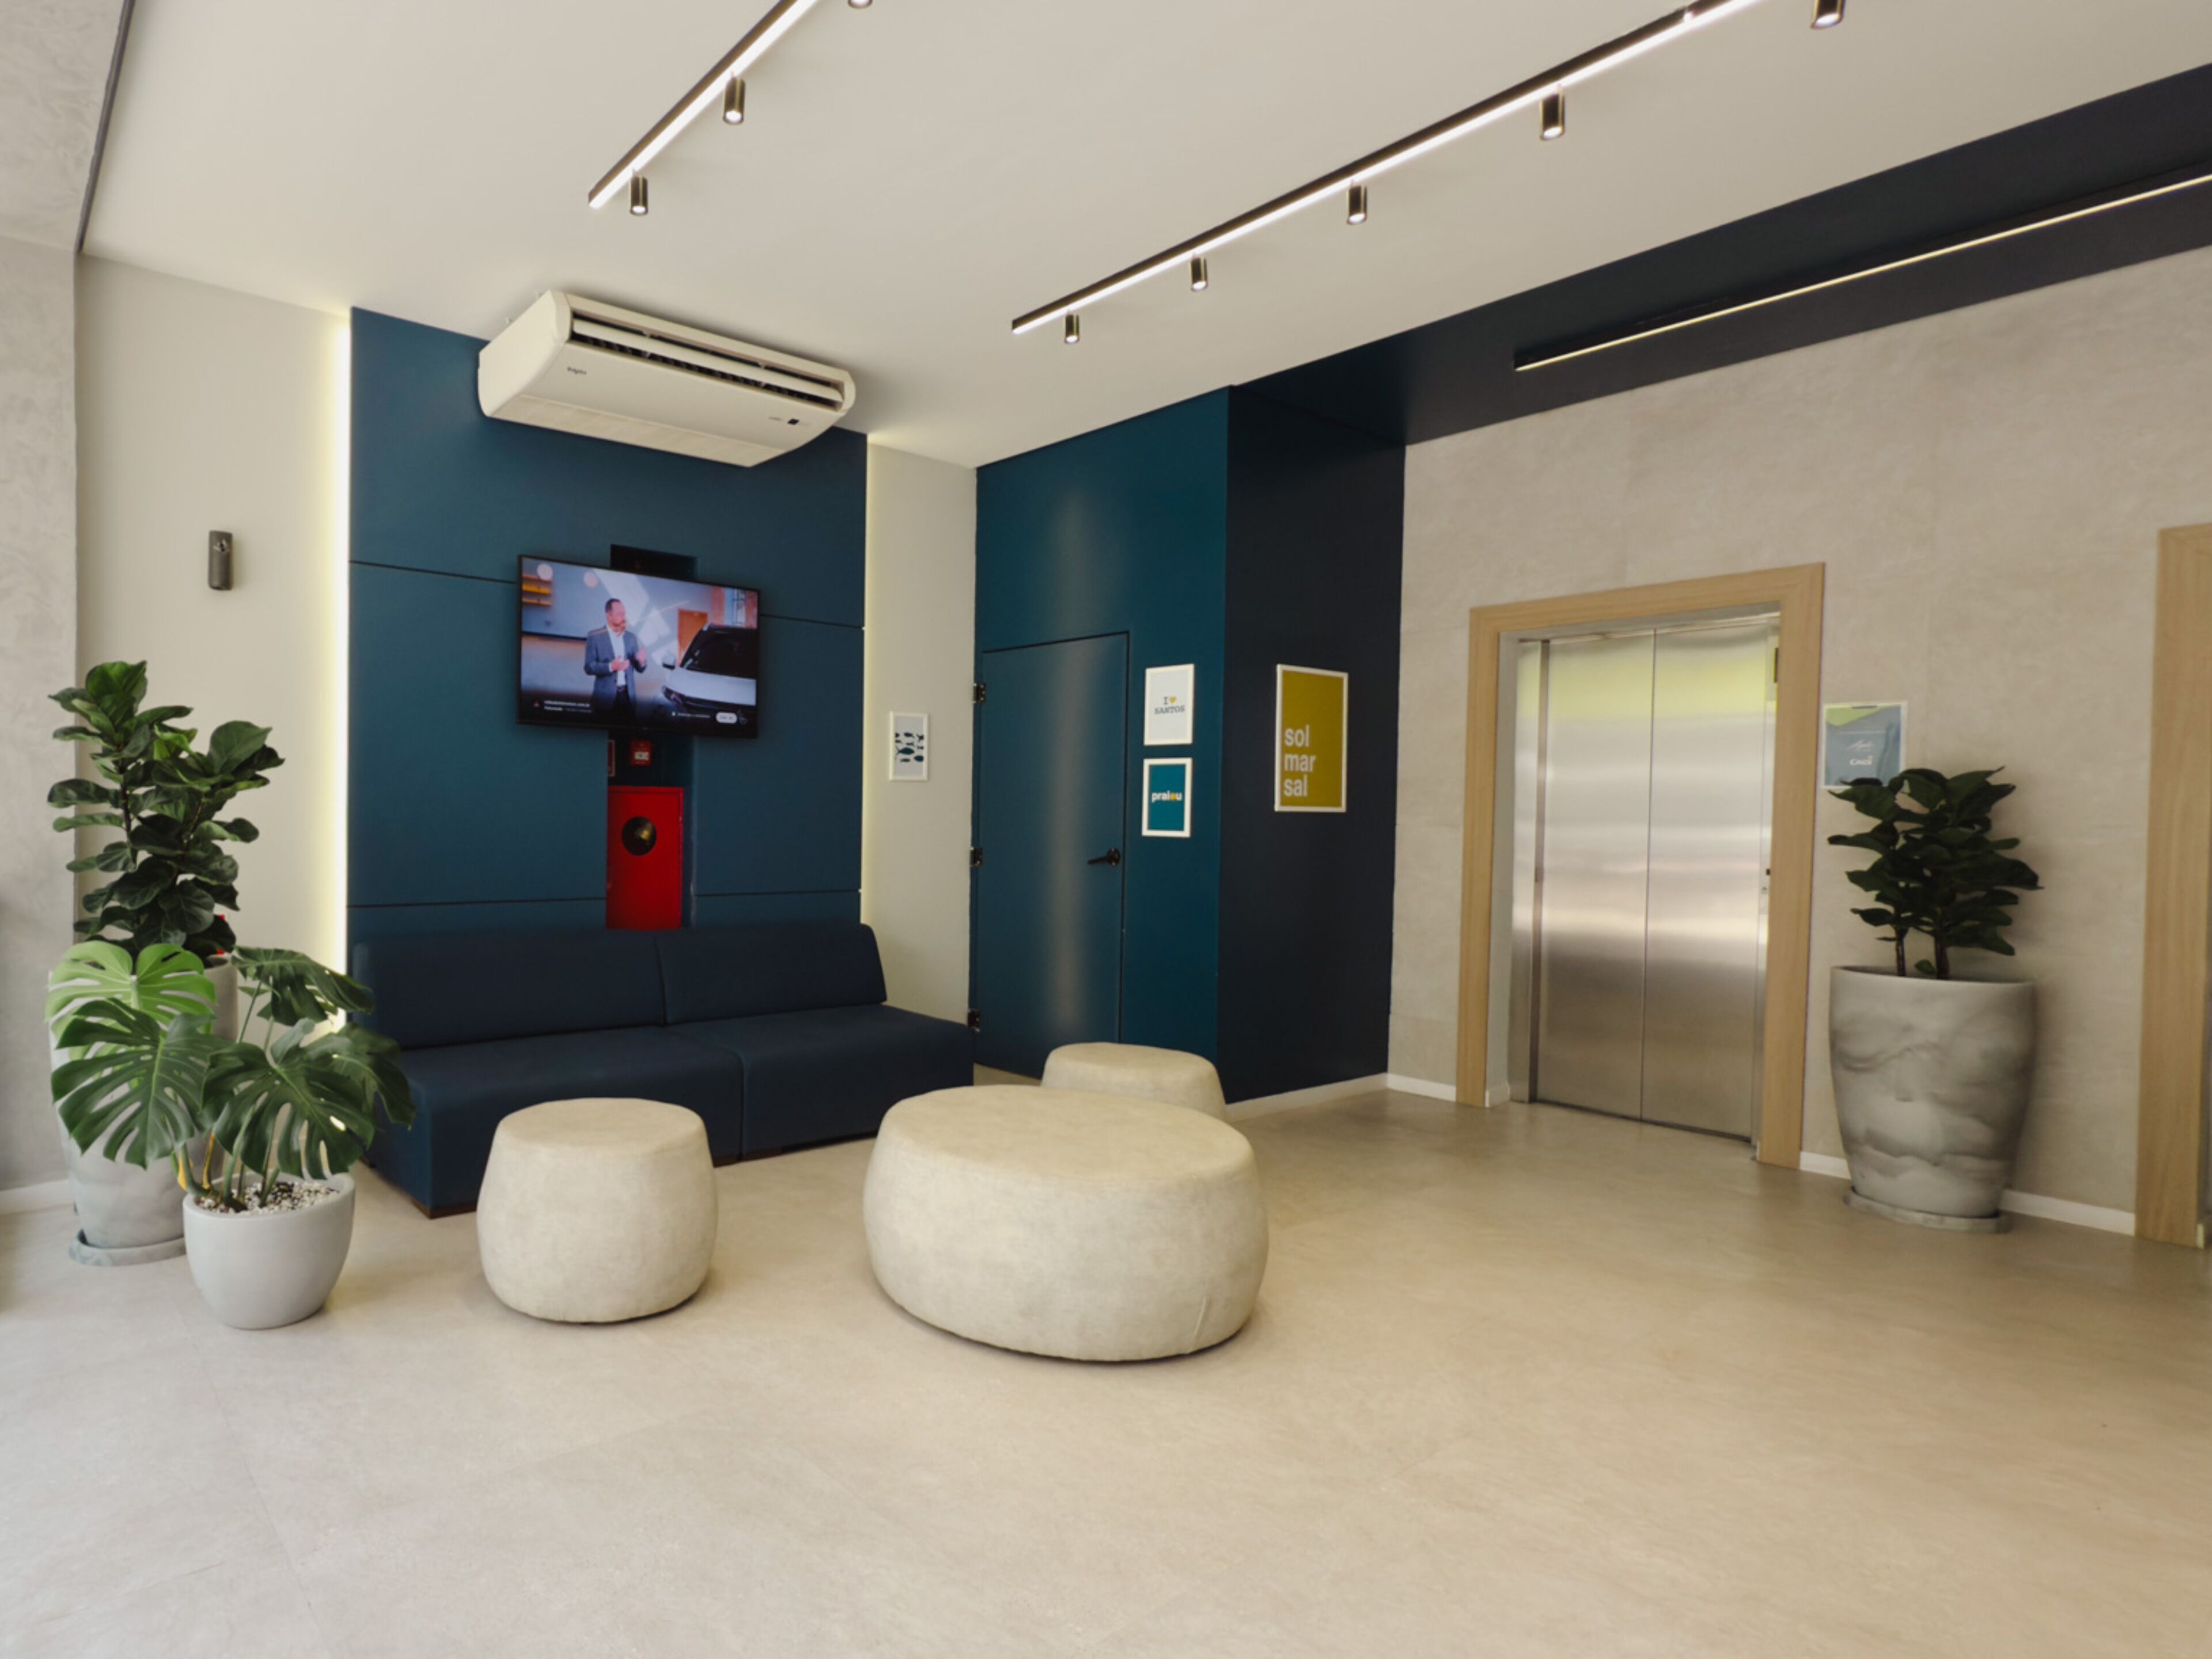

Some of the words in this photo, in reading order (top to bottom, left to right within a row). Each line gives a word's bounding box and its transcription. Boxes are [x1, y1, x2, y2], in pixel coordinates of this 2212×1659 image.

[1154, 705, 1185, 714] SANTOS
[1163, 696, 1168, 704] I
[1285, 724, 1309, 747] sol
[1284, 753, 1316, 772] mar
[1283, 774, 1308, 797] sal
